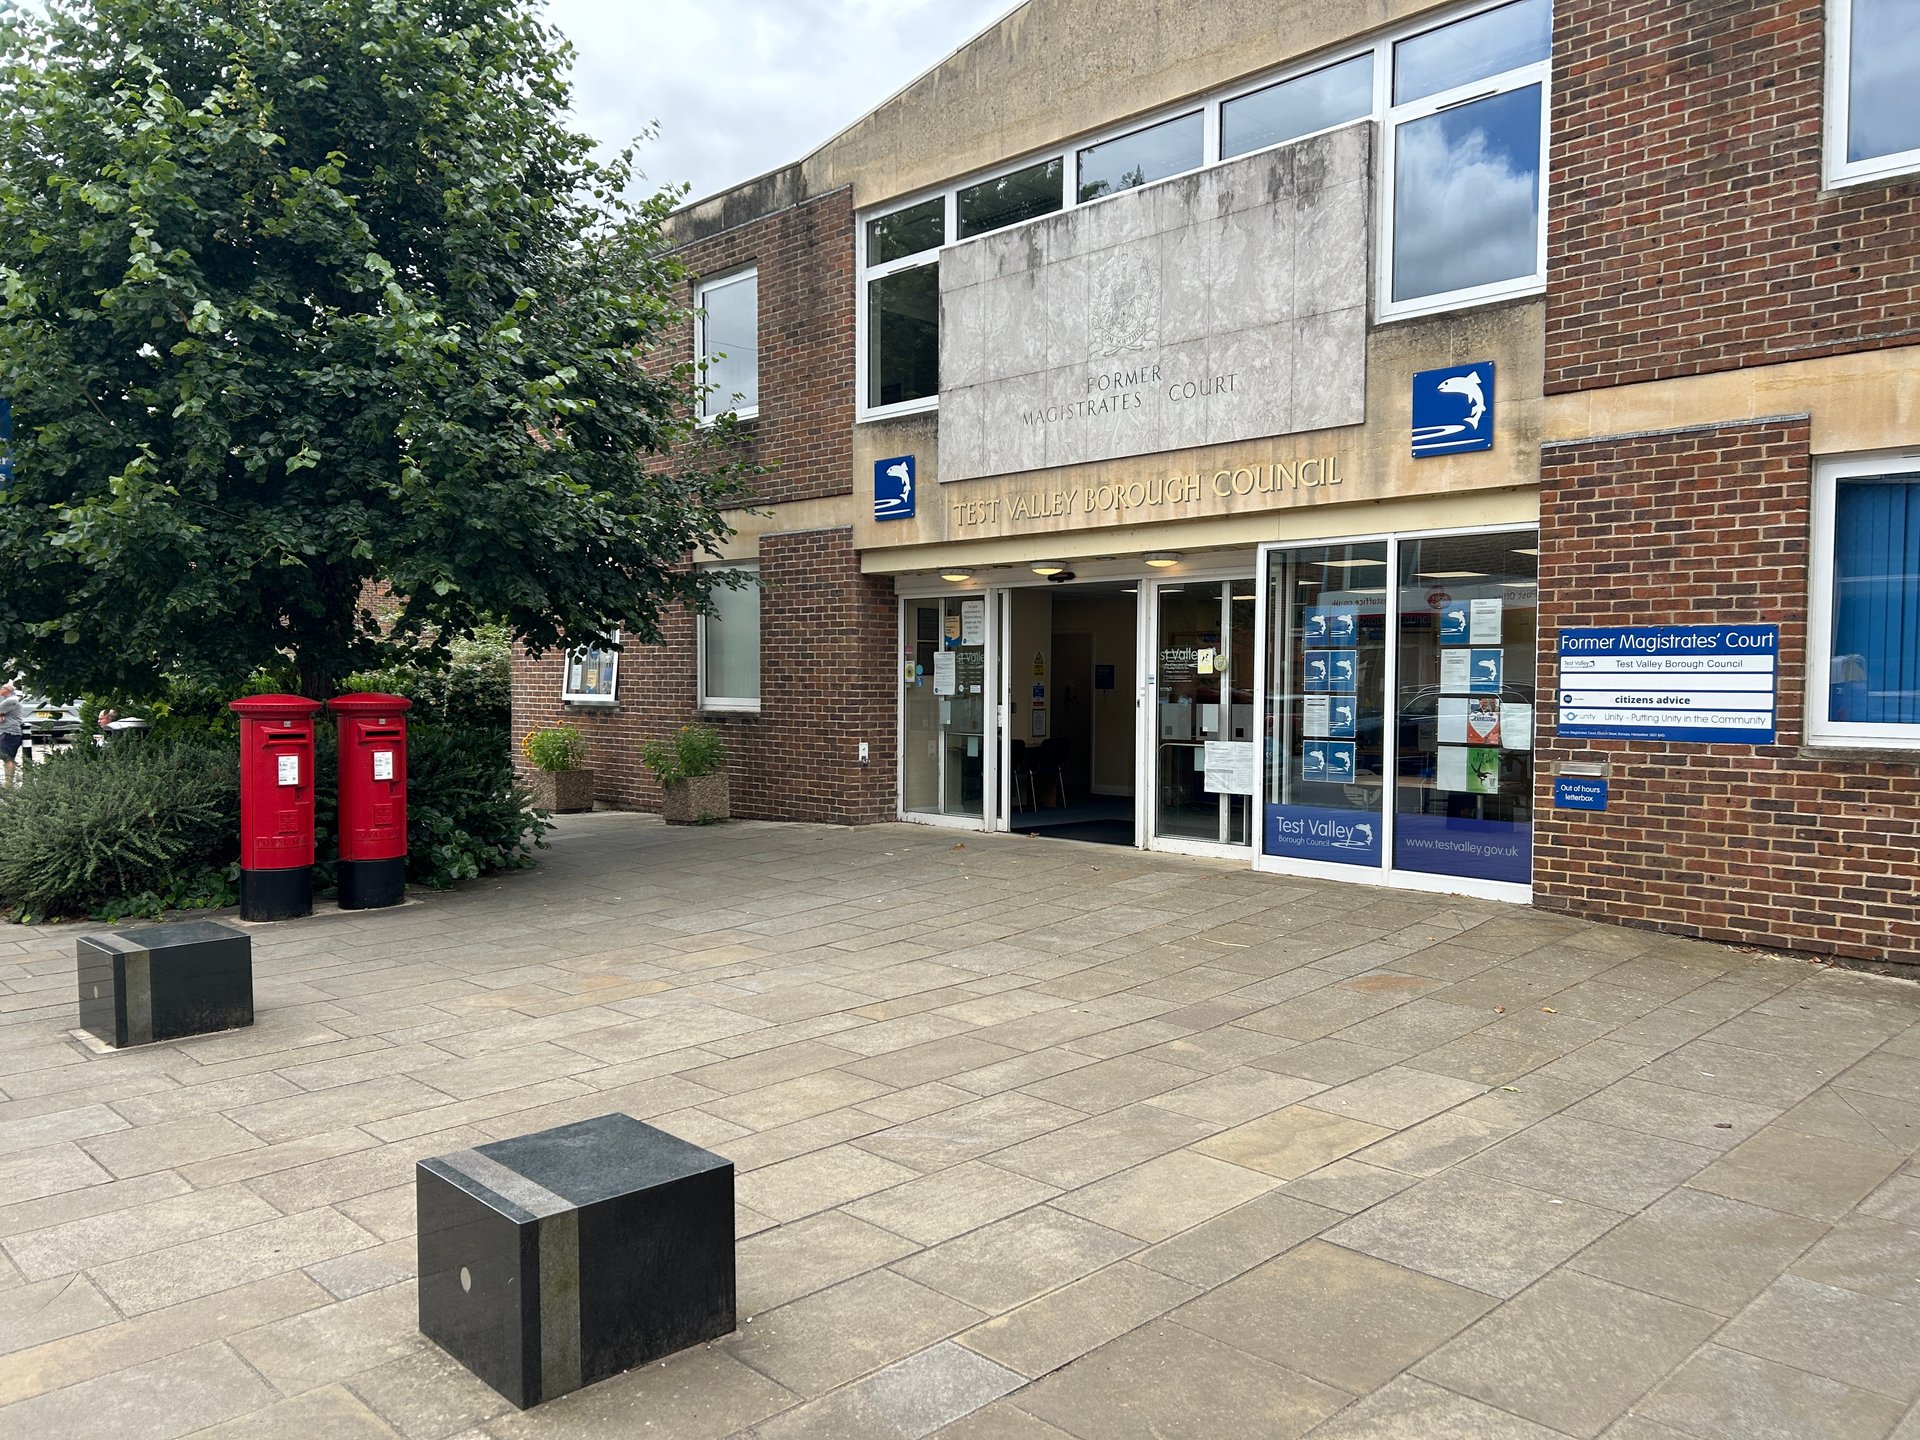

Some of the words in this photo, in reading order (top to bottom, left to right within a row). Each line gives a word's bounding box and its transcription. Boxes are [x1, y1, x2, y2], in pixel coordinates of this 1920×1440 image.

[1087, 364, 1162, 394] FORMER
[1022, 391, 1142, 426] MAGISTRATES
[1168, 373, 1238, 402] COURT
[953, 500, 1001, 526] TEST
[1005, 489, 1078, 521] VALLEY
[1083, 474, 1202, 513] BOROUGH
[1212, 456, 1343, 497] COUNCIL
[1561, 635, 1616, 650] Former
[1725, 632, 1774, 648] Court
[1615, 659, 1634, 668] Test
[1635, 659, 1663, 670] Valley
[1665, 659, 1704, 670] Borough
[1706, 659, 1743, 668] Council
[1614, 695, 1654, 704] citizens
[1656, 695, 1691, 705] advice
[1580, 713, 1596, 721] unity
[1604, 713, 1624, 722] Unity
[1631, 713, 1659, 724] Putting
[1661, 713, 1682, 724] Unity
[1683, 714, 1693, 722] in
[1694, 714, 1709, 723] the
[1710, 714, 1767, 725] Community
[1581, 785, 1601, 793] hours
[1564, 793, 1594, 802] letterbox
[1276, 816, 1305, 834] Test
[1308, 819, 1354, 847] Valley
[1278, 834, 1305, 846] Borough
[1306, 837, 1330, 847] Council
[1405, 838, 1519, 857] www.testvalley.gov.uk
